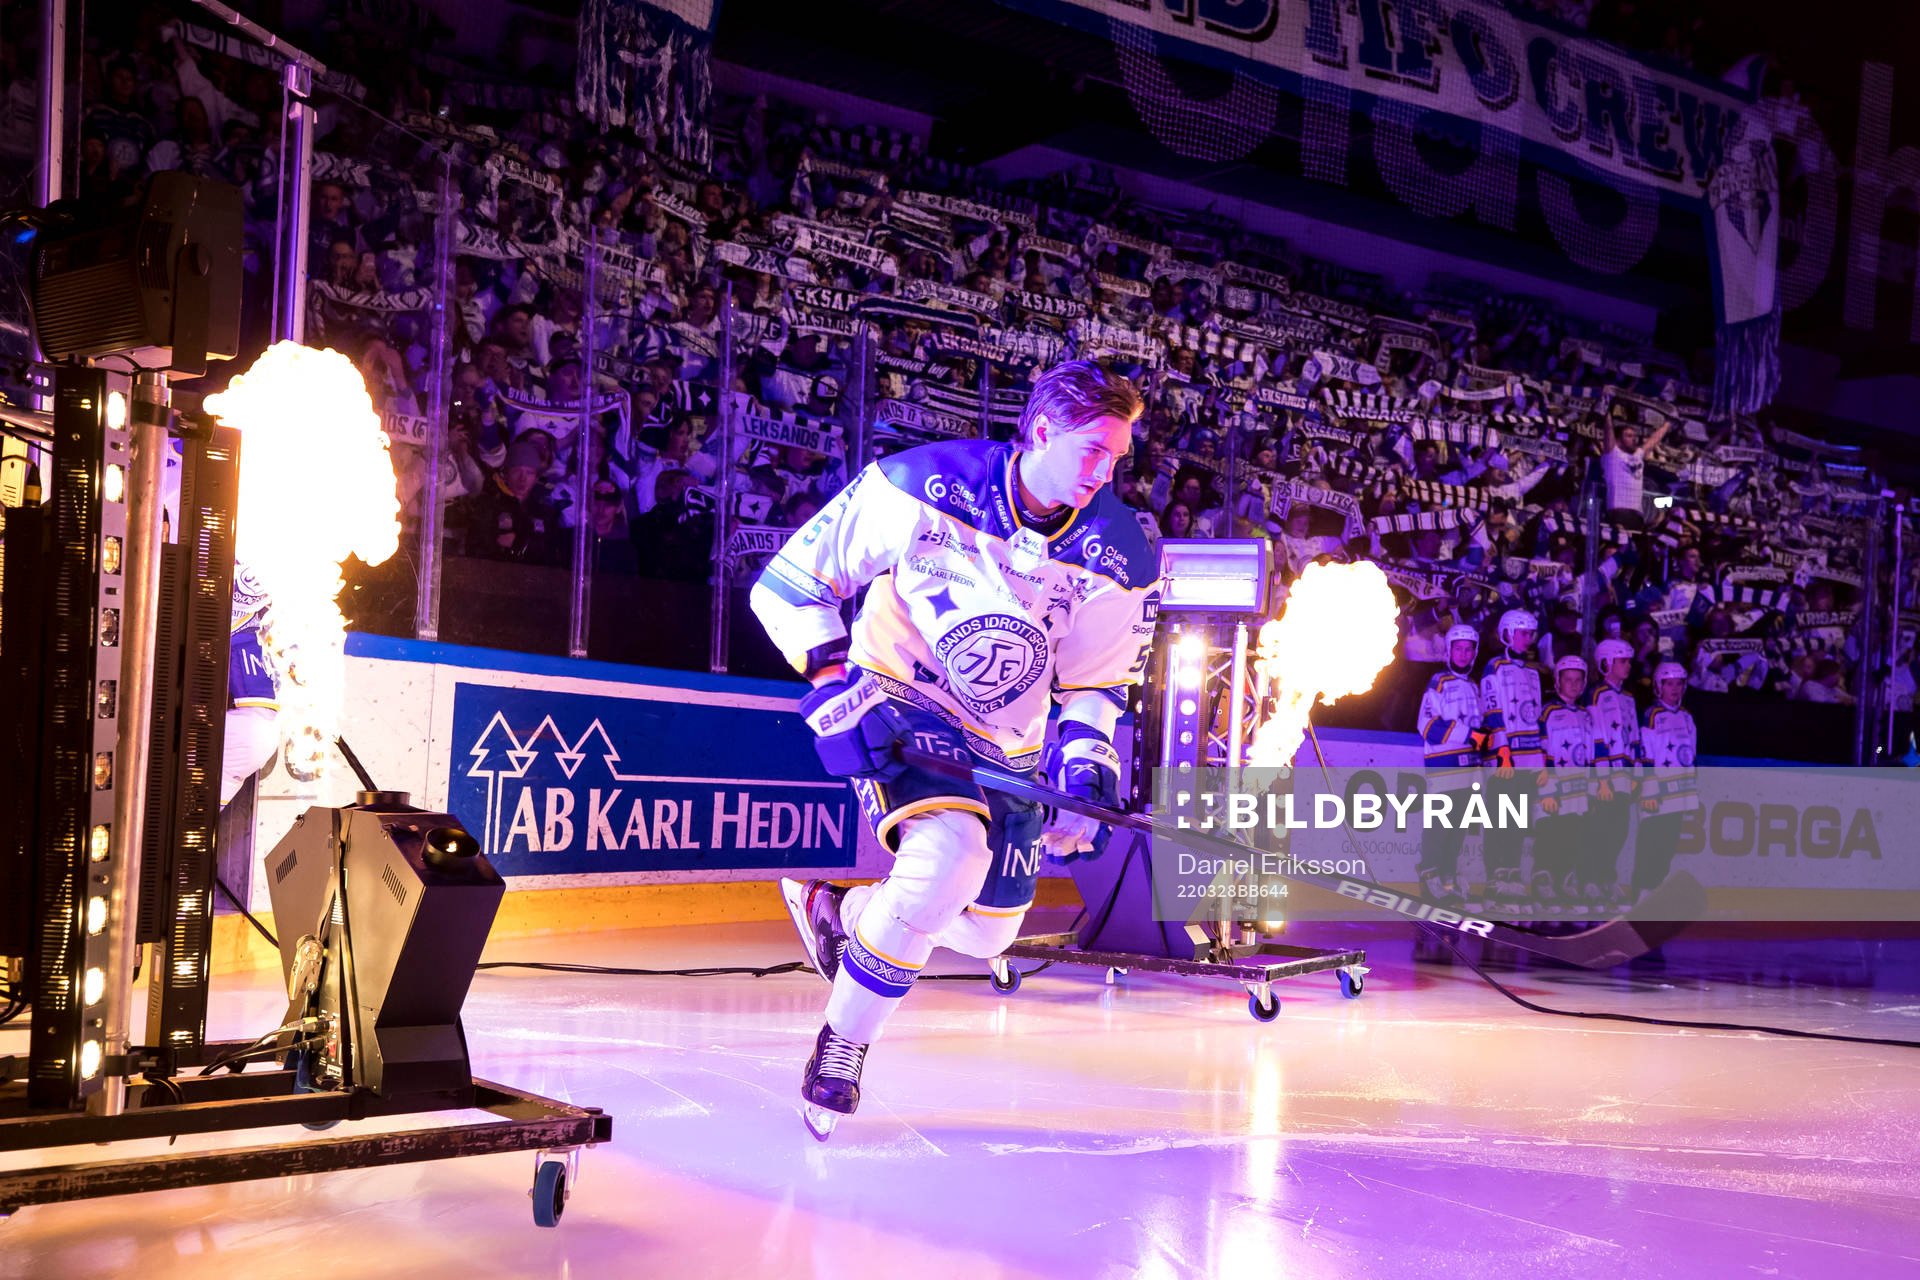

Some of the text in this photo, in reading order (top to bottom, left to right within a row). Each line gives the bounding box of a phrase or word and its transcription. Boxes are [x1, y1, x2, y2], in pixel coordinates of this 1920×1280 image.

[742, 415, 836, 453] LEKSANDS IF
[950, 481, 976, 502] Clas
[949, 494, 987, 519] Ohlson
[994, 494, 1010, 530] TEGERA
[1060, 525, 1089, 549] TEGERA
[1105, 545, 1129, 566] Clas
[914, 563, 976, 588] AB KARL HEDIN
[1003, 565, 1042, 585] TEGERA
[1101, 555, 1130, 584] Ohlson
[503, 786, 578, 853] AB
[586, 788, 700, 852] KARL
[709, 791, 845, 851] HEDIN
[1675, 800, 1883, 860] BORGA
